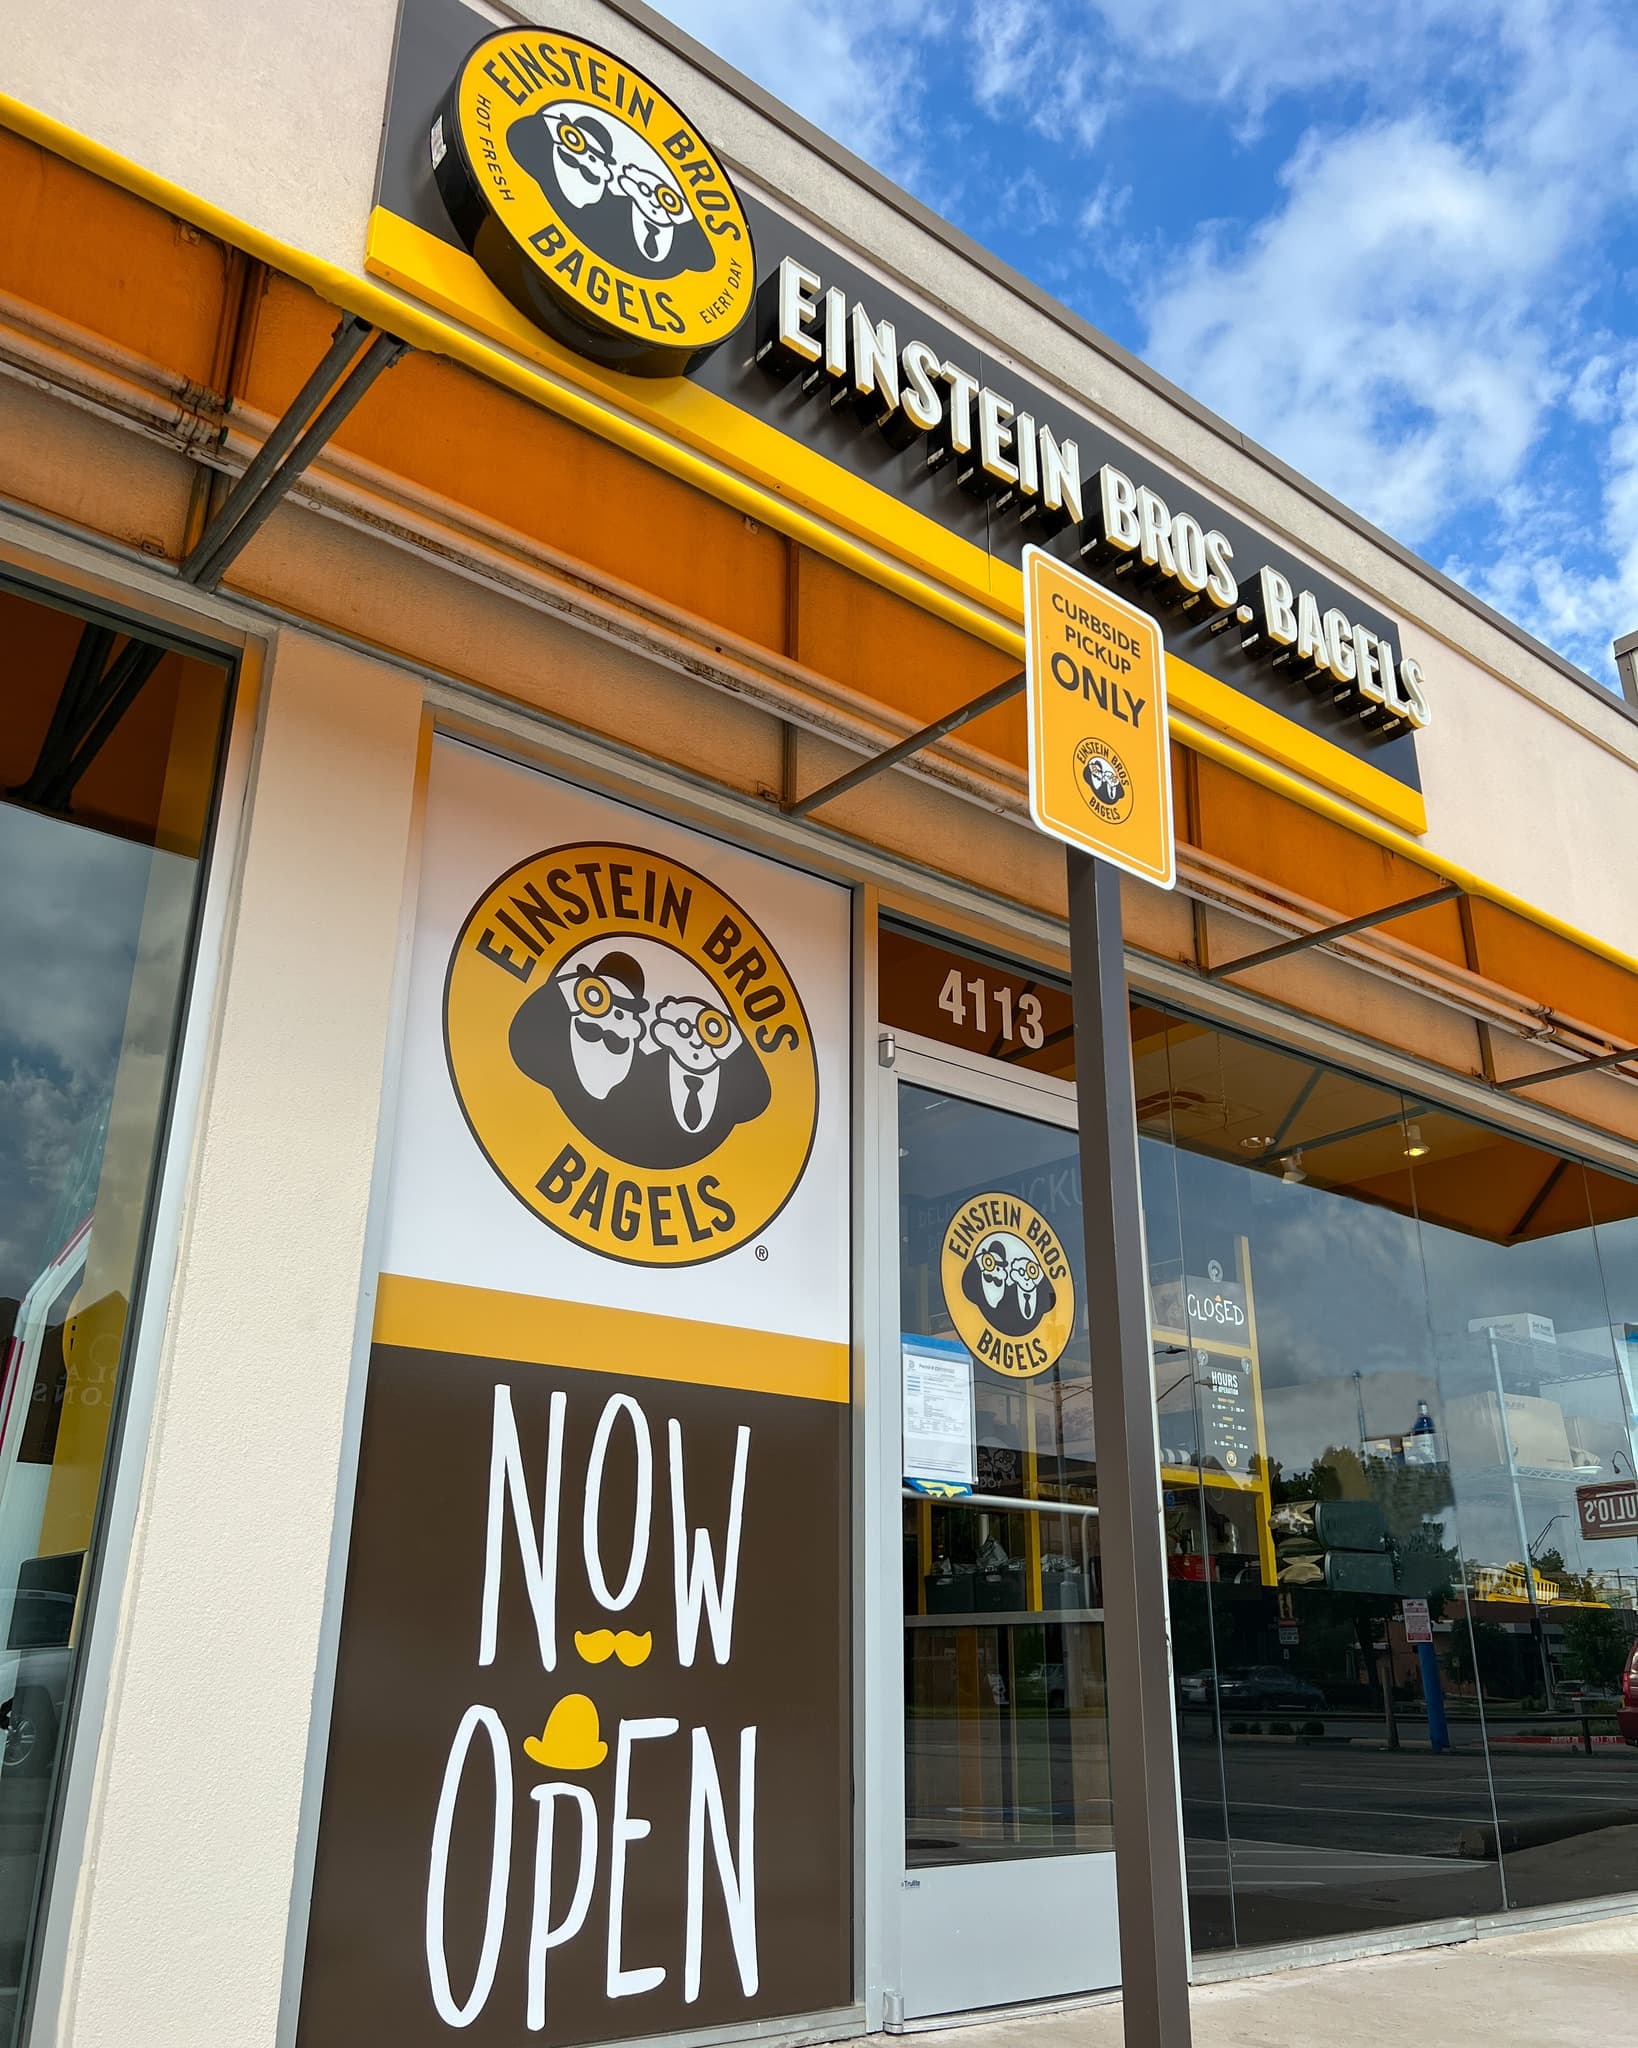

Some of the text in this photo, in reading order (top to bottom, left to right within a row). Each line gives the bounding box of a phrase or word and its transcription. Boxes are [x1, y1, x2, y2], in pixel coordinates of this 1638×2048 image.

[476, 93, 516, 202] HOT FRESH
[483, 42, 742, 242] EINSTEIN BROS
[528, 222, 686, 335] BAGELS
[700, 257, 744, 325] EVERY DAY
[778, 256, 1432, 729] EINSTEIN BROS. BAGELS
[1051, 592, 1141, 659] CURBSIDE
[1065, 624, 1132, 675] PICKUP
[1050, 651, 1146, 729] ONLY
[1076, 741, 1130, 787] EINSTEIN BROS
[1088, 797, 1121, 821] BAGELS
[475, 862, 799, 1054] EINSTEIN BROS
[938, 968, 1045, 1050] 4113
[534, 1143, 737, 1246] BAGELS
[948, 1200, 1022, 1261] EINSTEIN
[1025, 1216, 1067, 1281] BROS
[976, 1327, 1048, 1371] BAGELS
[1187, 1293, 1245, 1326] CLOSED
[1211, 1371, 1239, 1388] HOURS
[478, 1383, 752, 1673] NOW
[425, 1703, 759, 2032] OPEN
